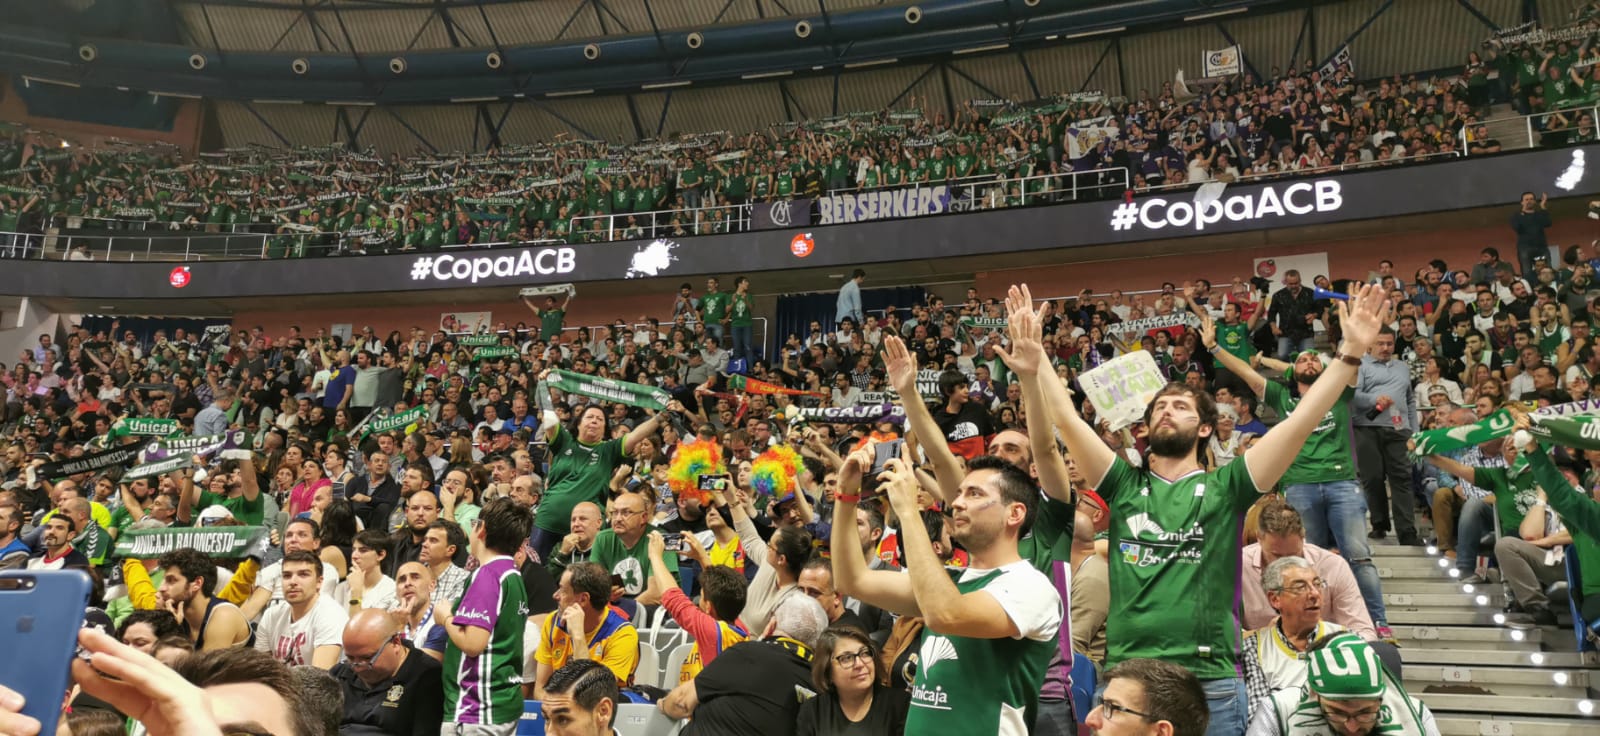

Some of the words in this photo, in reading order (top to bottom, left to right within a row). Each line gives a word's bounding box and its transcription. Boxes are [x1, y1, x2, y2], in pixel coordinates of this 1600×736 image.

[316, 191, 350, 201] UNICAJA
[819, 186, 947, 225] BERSERKERS
[1111, 179, 1343, 231] #CopaACB
[410, 247, 576, 283] #CopaACB
[864, 393, 882, 401] REA
[373, 410, 421, 431] Unicaja
[799, 405, 884, 418] NICAJA
[131, 533, 174, 554] UNICAJA
[175, 532, 236, 553] BALONCESTO
[1453, 671, 1461, 679] 6
[911, 684, 948, 706] Unicaja
[1492, 725, 1500, 733] 5
